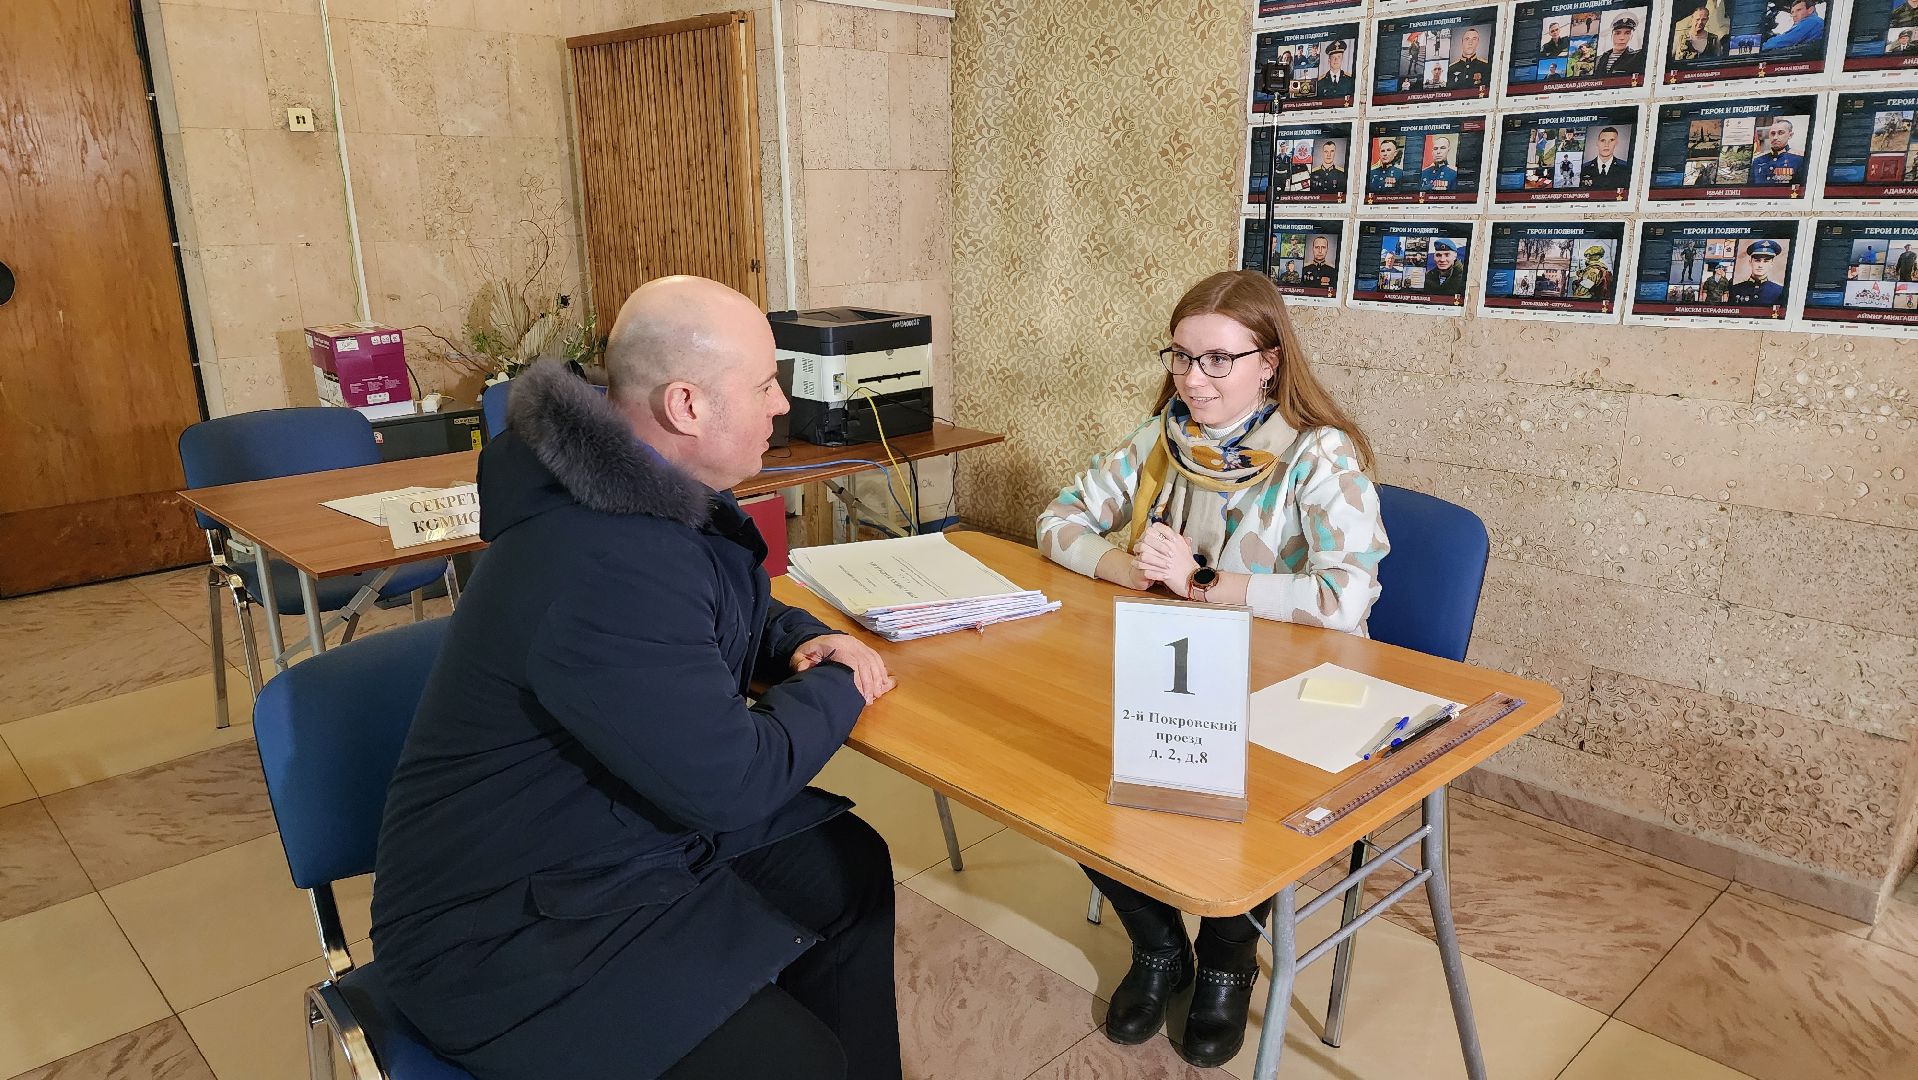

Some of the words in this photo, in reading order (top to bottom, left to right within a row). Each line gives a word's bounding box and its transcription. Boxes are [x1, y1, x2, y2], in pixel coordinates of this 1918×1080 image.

[1700, 107, 1725, 116] ГЕРОИ
[1732, 104, 1770, 114] ПОДВИГИ
[1886, 98, 1914, 106] ГЕРОИ
[1714, 227, 1751, 235] ПОДВИГИ
[1865, 227, 1893, 235] ГЕРОИ
[410, 492, 478, 514] СЕКРЕТ
[412, 511, 480, 533] КОМИС
[1164, 636, 1196, 695] 1
[1122, 709, 1144, 722] 2-й
[1149, 711, 1238, 732] Покровский
[1156, 731, 1203, 746] проезд
[1149, 748, 1163, 760] д.
[1168, 748, 1181, 763] 2,
[1185, 751, 1208, 765] д.8
